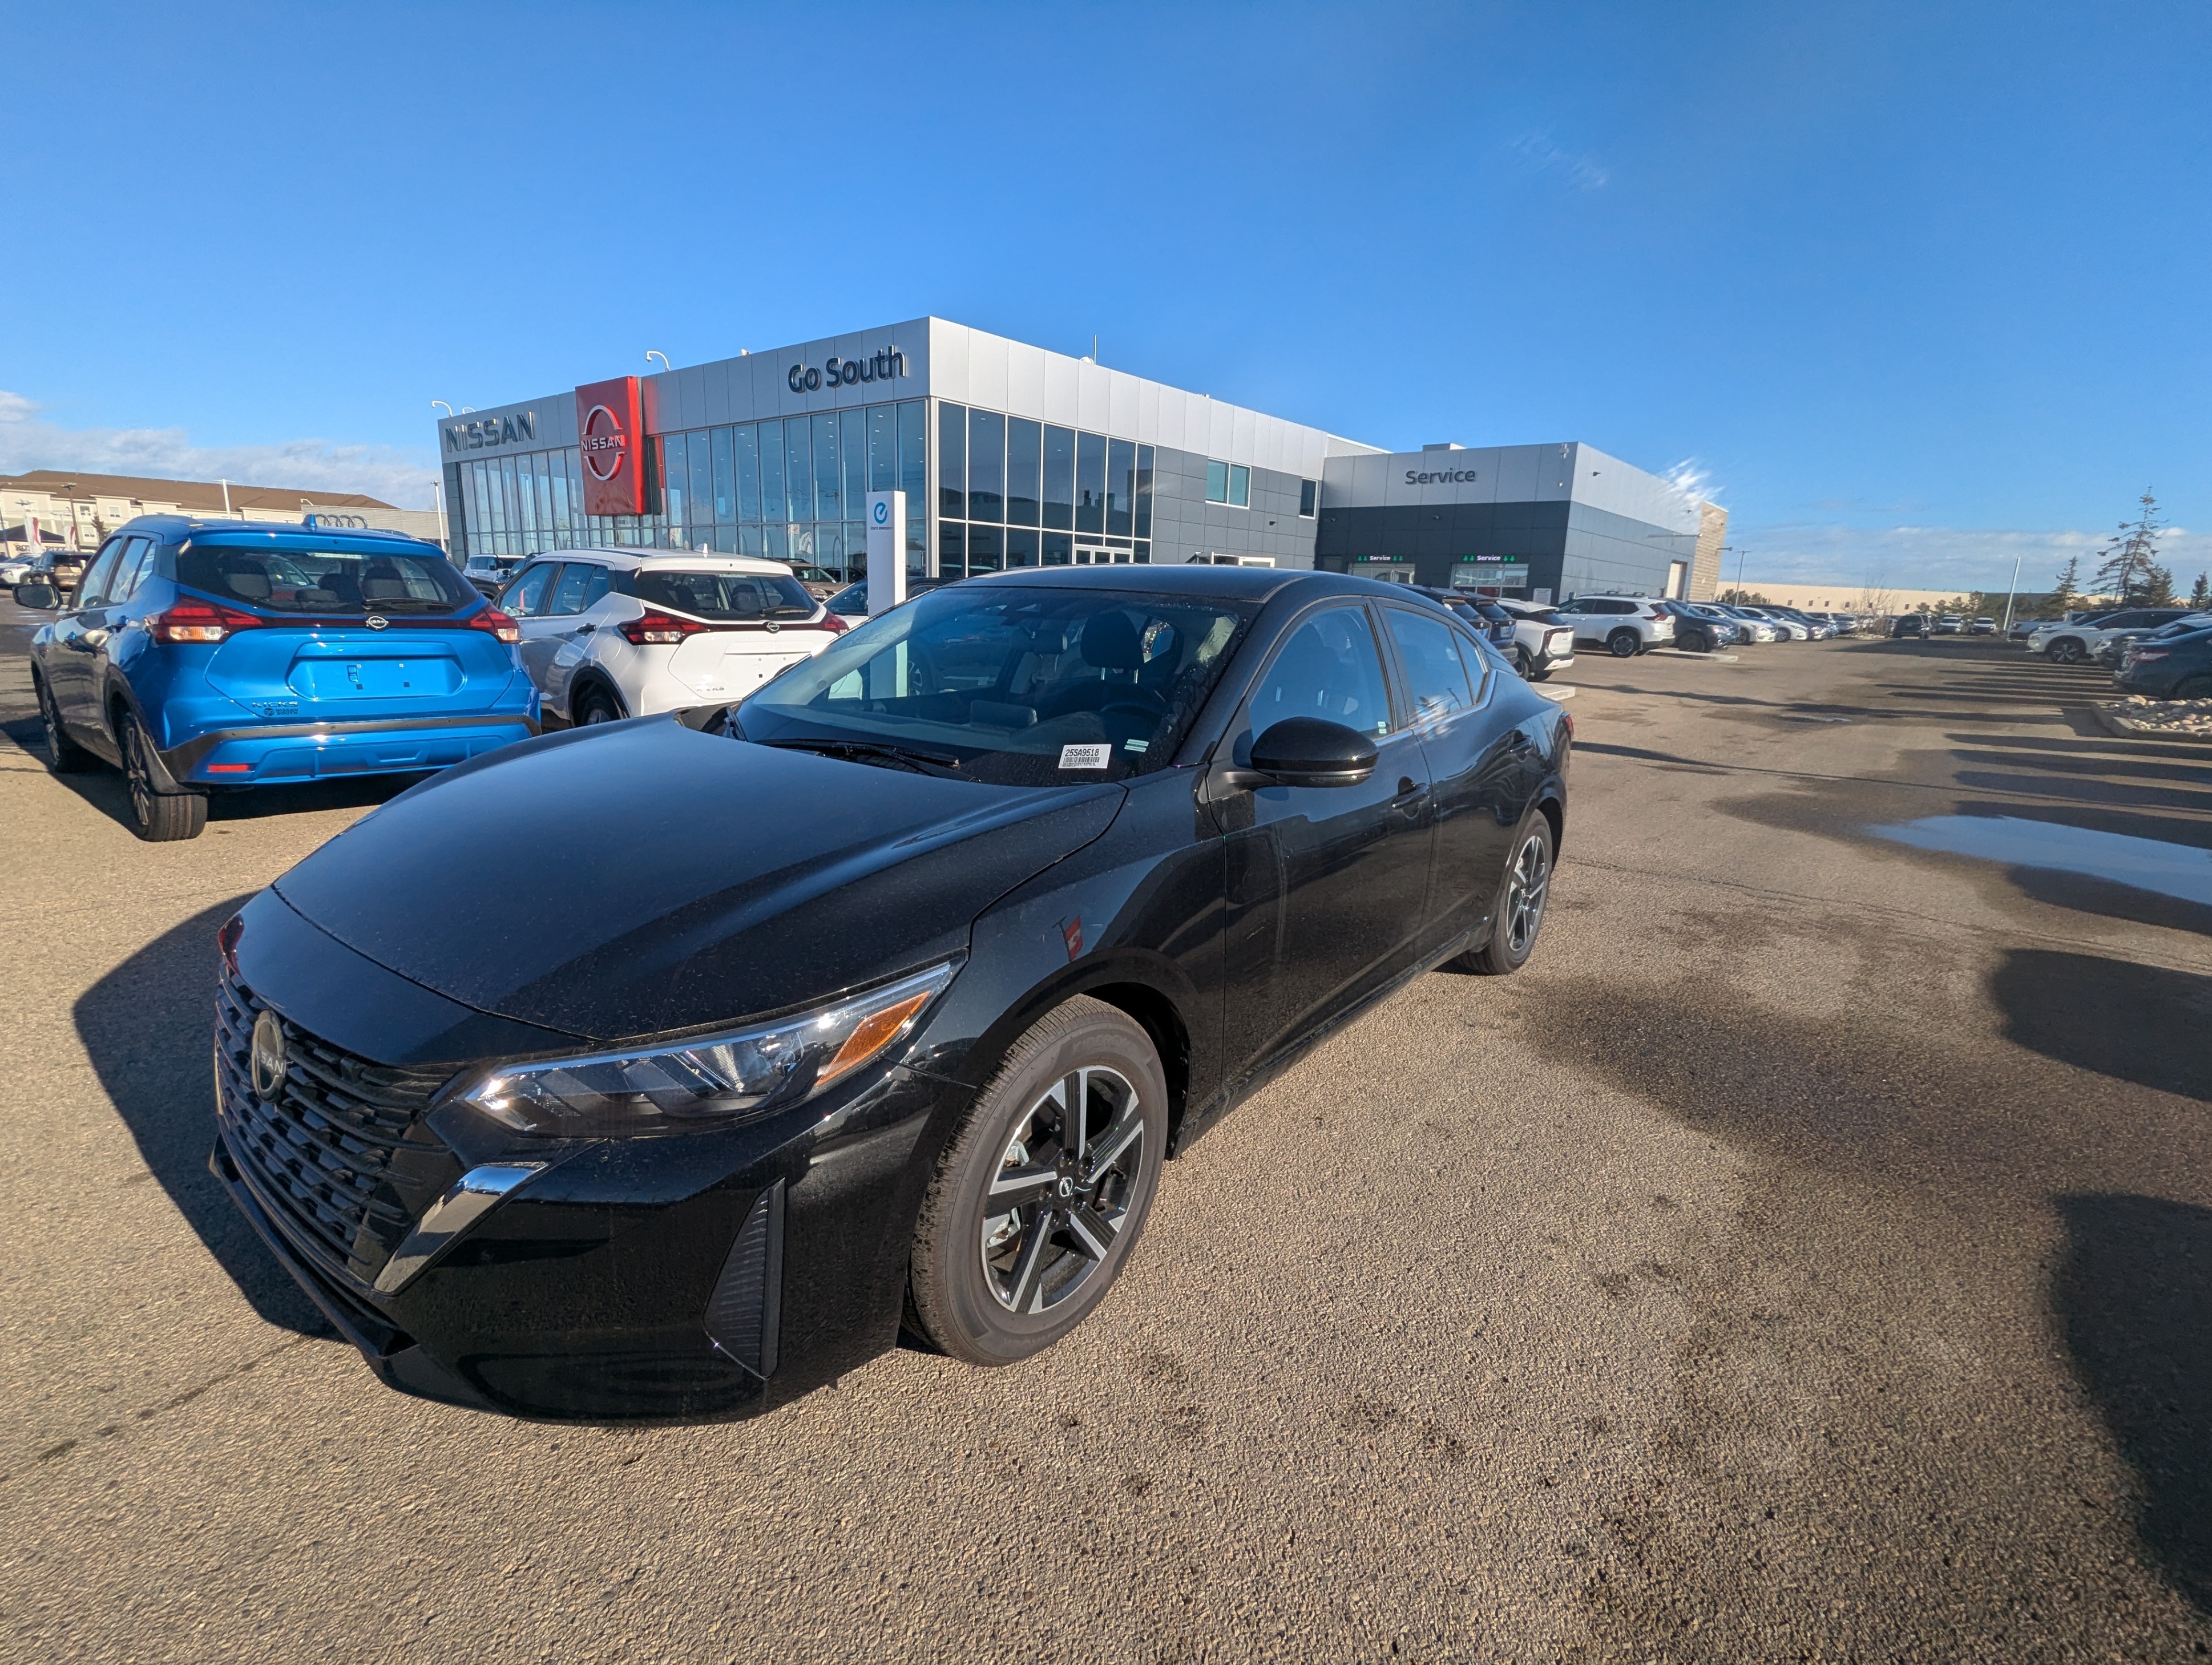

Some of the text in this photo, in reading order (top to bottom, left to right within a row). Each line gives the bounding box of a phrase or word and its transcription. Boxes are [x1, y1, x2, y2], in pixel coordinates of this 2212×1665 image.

[788, 345, 906, 393] Go South
[445, 411, 534, 452] NISSAN
[581, 434, 628, 451] NISSAN
[1405, 467, 1476, 484] Service
